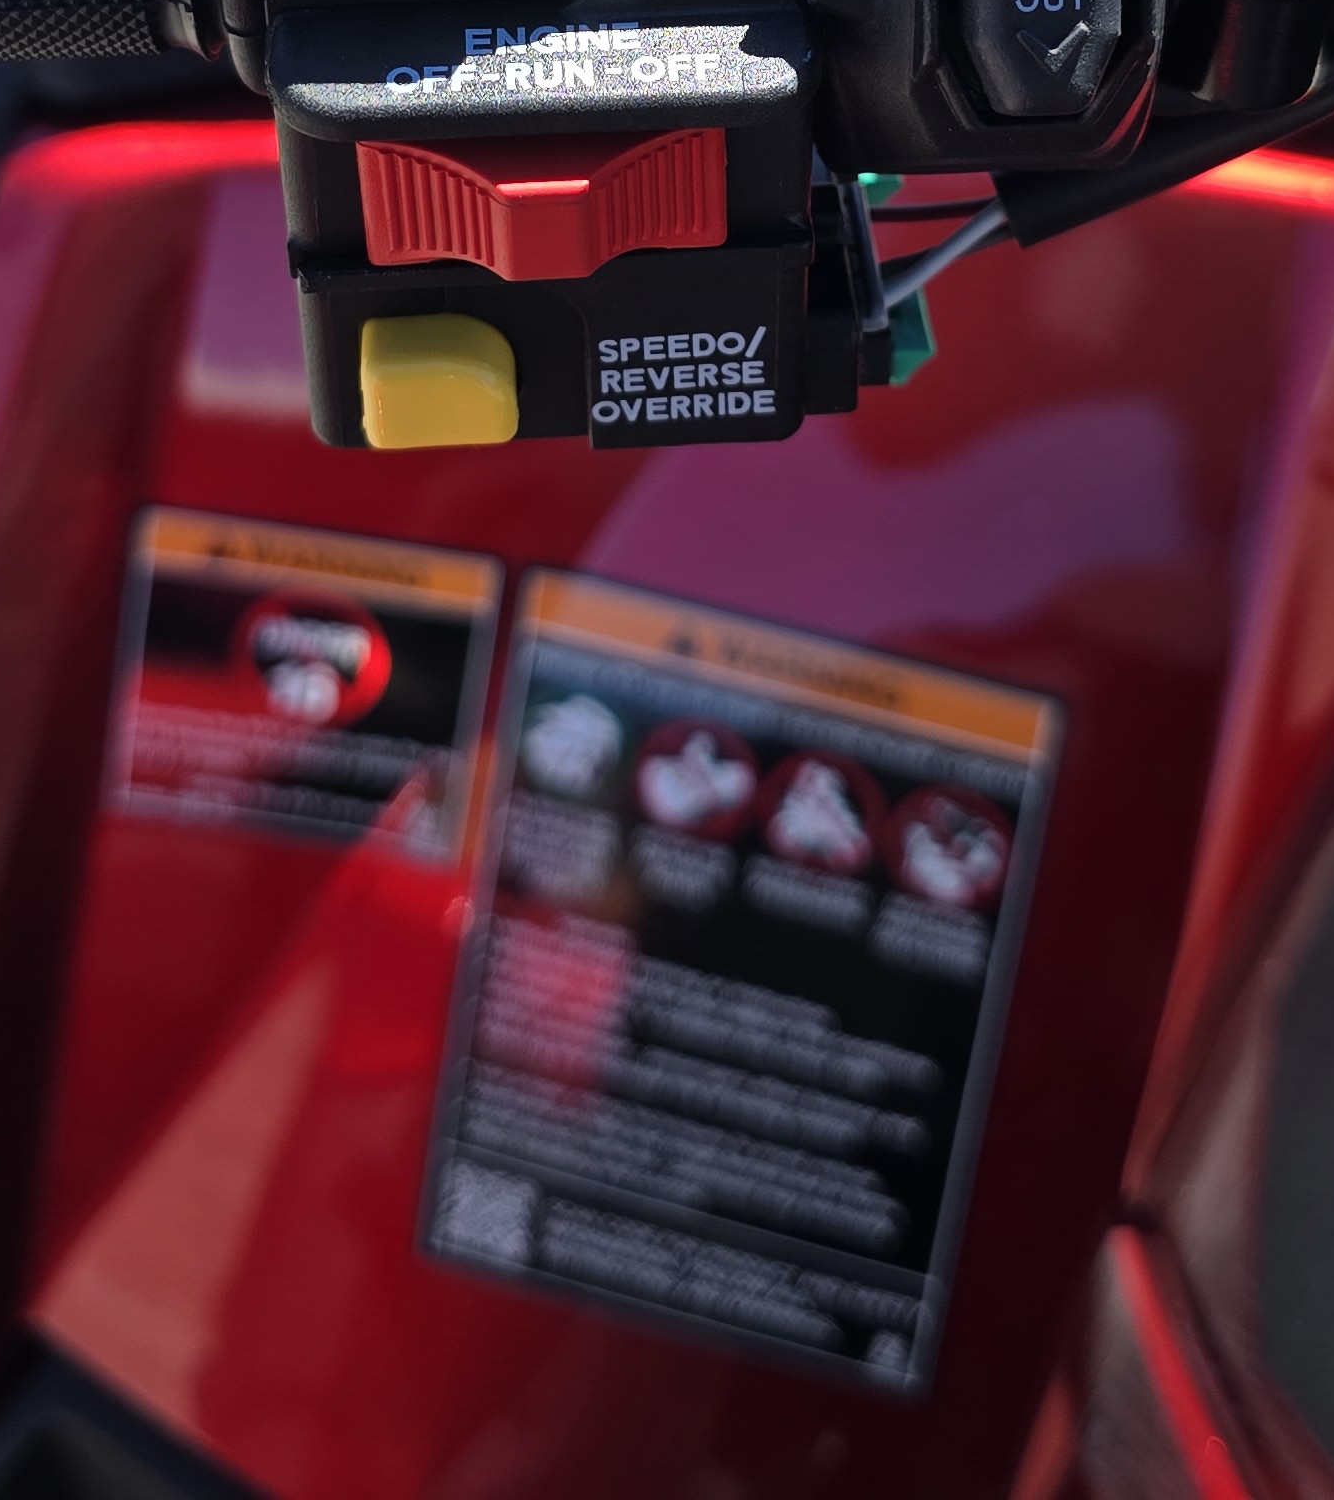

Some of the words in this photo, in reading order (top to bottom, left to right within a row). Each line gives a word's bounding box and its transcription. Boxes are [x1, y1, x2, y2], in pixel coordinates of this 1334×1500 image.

[464, 21, 641, 57] ENGINE
[597, 325, 767, 363] SPEEDO/
[600, 360, 766, 394] REVERSE
[591, 389, 777, 424] OVERRIDE
